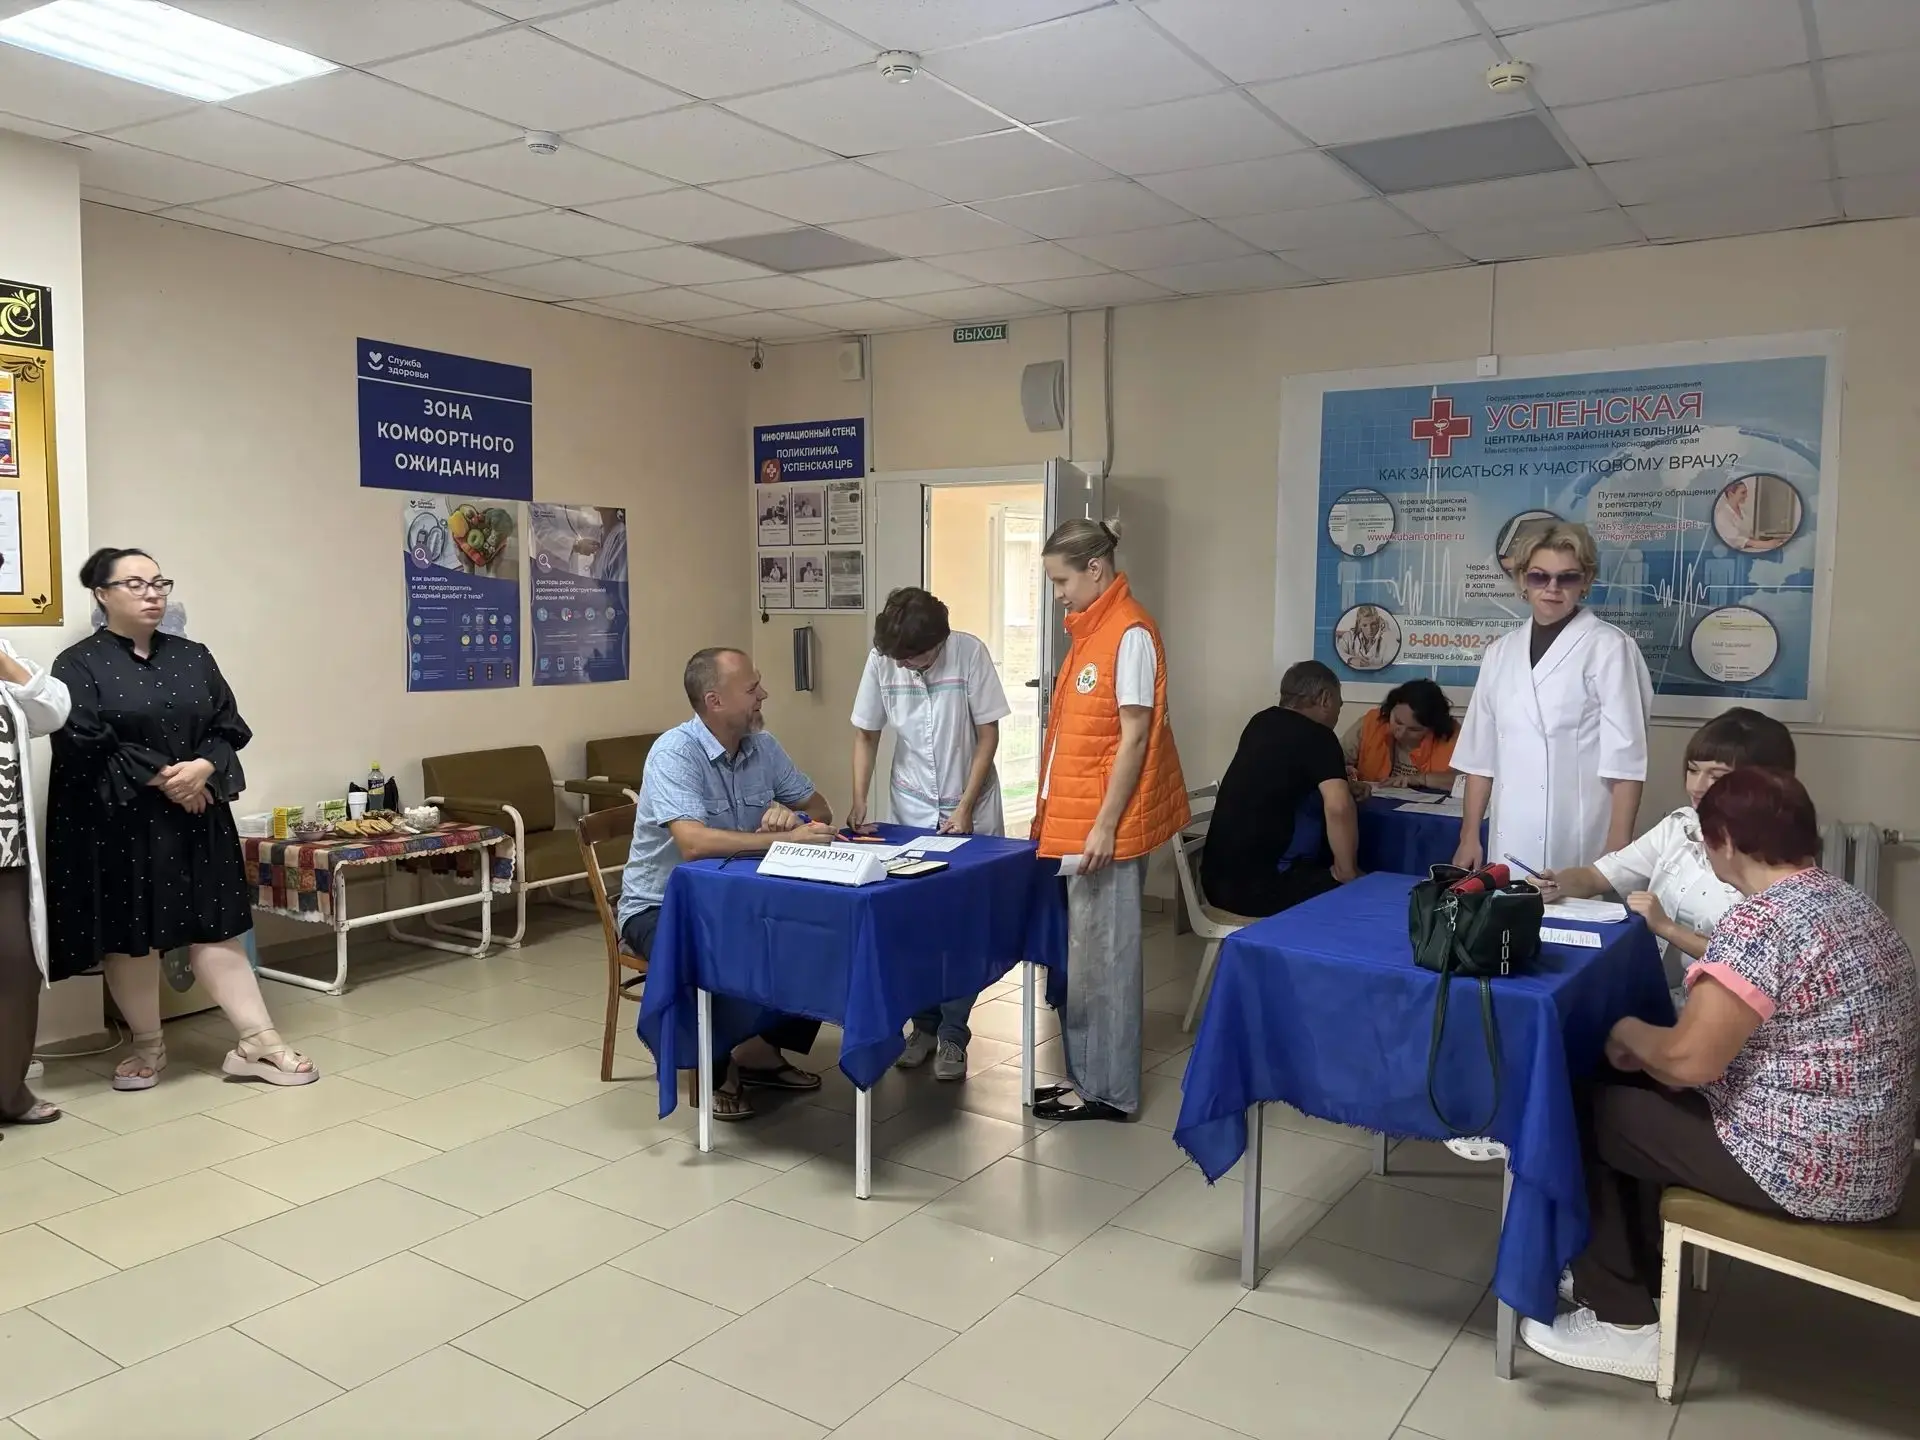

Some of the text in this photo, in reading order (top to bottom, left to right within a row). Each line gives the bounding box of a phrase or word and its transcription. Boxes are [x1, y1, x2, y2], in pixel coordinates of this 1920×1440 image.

[956, 326, 1003, 341] ВЫХОД
[387, 355, 422, 369] Служба
[388, 366, 429, 380] здоровья
[423, 398, 473, 421] ЗОНА
[1484, 392, 1703, 432] УСПЕНСКАЯ
[377, 421, 515, 454] КОМФОРТНОГО
[761, 426, 857, 442] ИНФОРМАЦИОННЫЙ СТЕНД
[1484, 424, 1701, 446] ЦЕНТРАЛЬНАЯ РАЙОННАЯ БОЛЬНИЦА
[1611, 437, 1678, 449] Краснодарского
[1680, 436, 1700, 446] края
[776, 445, 839, 458] ПОЛИКЛИНИКА
[395, 453, 500, 479] ОЖИДАНИЯ
[783, 459, 853, 473] УСПЕНСКАЯ ЦРБ
[1379, 453, 1739, 481] КАК ЗАПИСАТЬСЯ К УЧАСТКОВОМУ ВРАЧУ?
[1598, 491, 1625, 500] Путем
[1665, 488, 1717, 498] обращения
[1605, 501, 1662, 510] регистратуру
[1404, 619, 1445, 627] ПОЗВОНИТЬ
[1485, 620, 1525, 628] КОЛ-ЦЕНТР
[1403, 652, 1445, 660] ЕЖЕДНЕВНО
[773, 845, 855, 863] РЕГИСТРАТУРА
